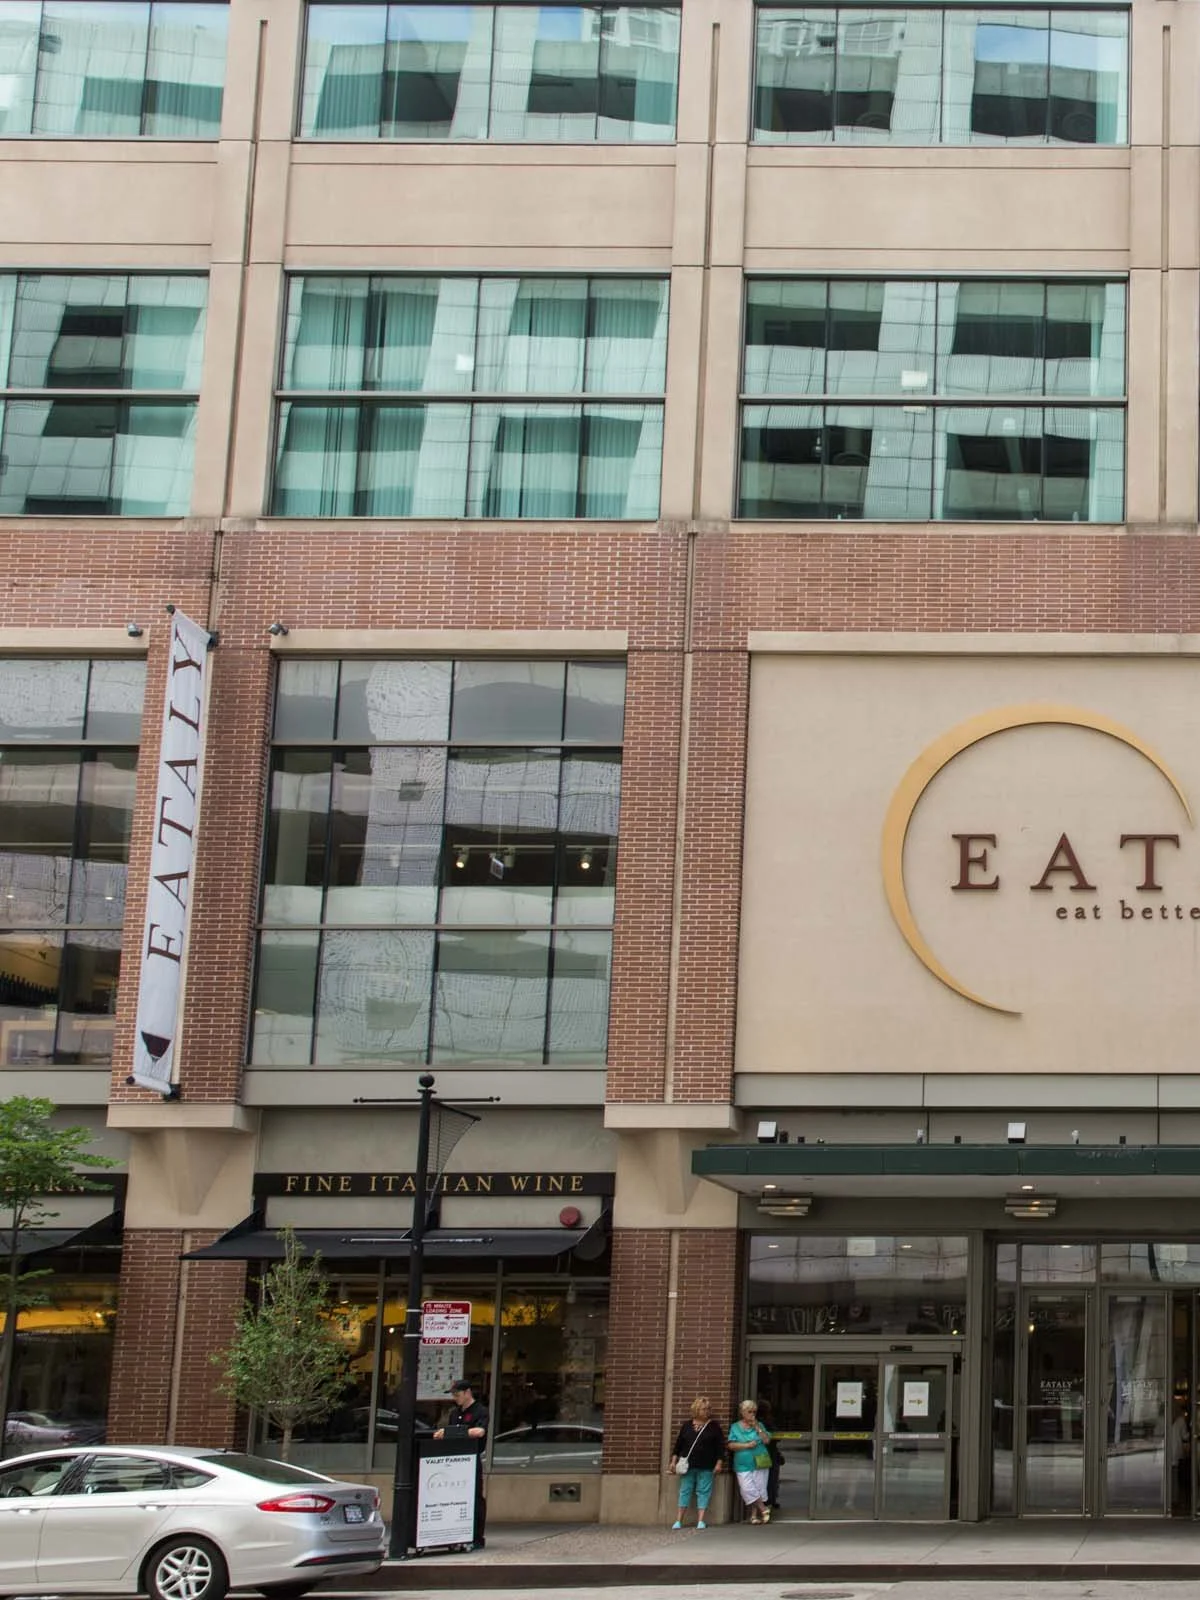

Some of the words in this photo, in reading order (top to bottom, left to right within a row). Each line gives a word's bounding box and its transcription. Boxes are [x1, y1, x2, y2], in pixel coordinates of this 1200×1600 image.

[146, 623, 202, 963] EATALY
[1056, 901, 1102, 921] eat
[285, 1175, 353, 1192] FINE
[369, 1175, 493, 1192] ITALIAN
[510, 1175, 584, 1192] WINE
[1040, 1380, 1073, 1389] EATALY
